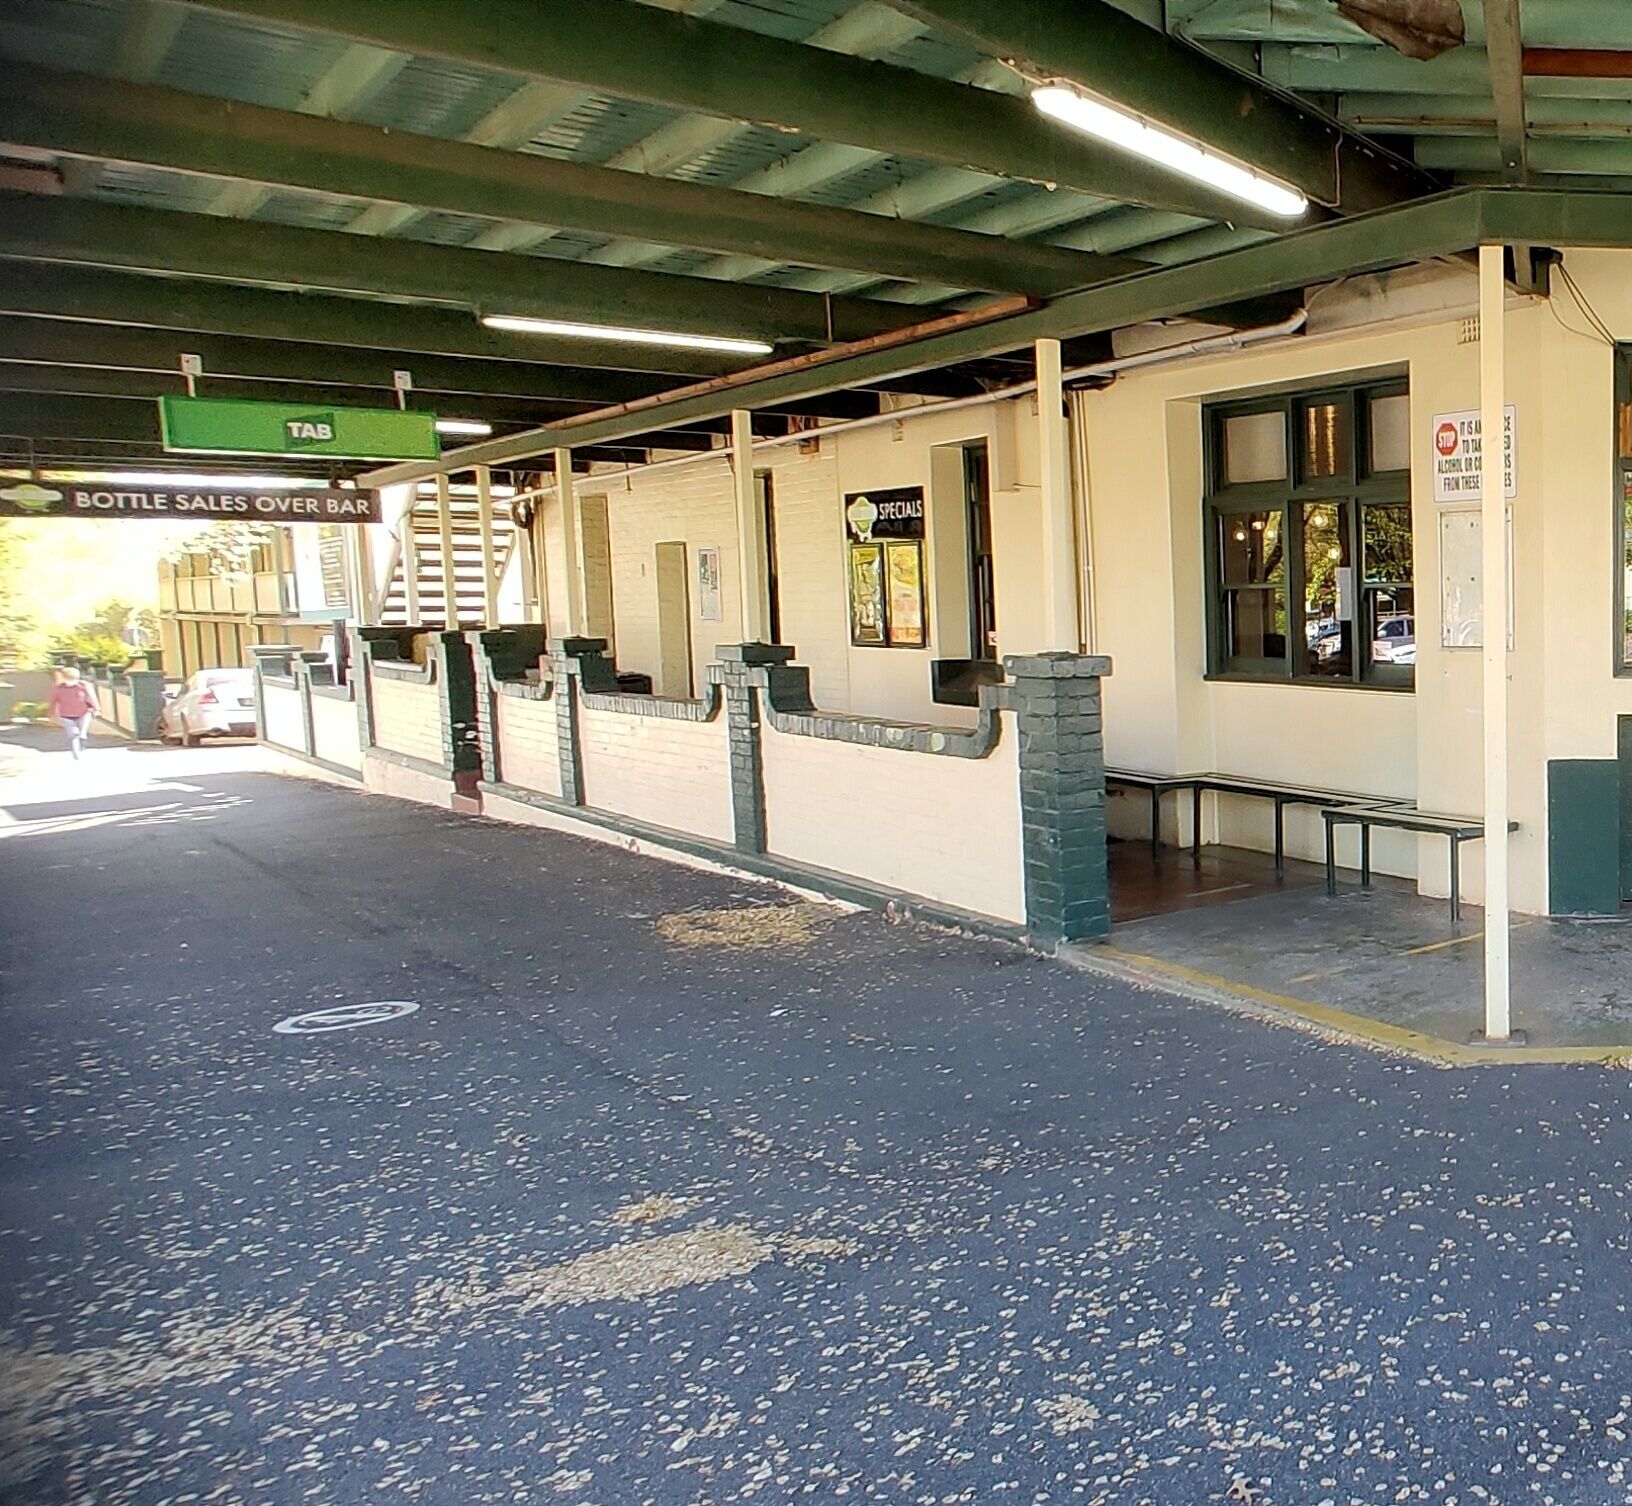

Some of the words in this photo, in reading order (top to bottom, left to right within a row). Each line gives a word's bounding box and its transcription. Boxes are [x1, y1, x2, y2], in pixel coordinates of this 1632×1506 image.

[287, 422, 332, 440] TAB
[1460, 420, 1466, 436] IT
[1467, 420, 1473, 435] IS
[1439, 431, 1456, 449] STOP
[1462, 439, 1470, 454] TO
[1471, 438, 1482, 453] TAK
[1438, 458, 1463, 474] ALCOHOL
[1464, 457, 1473, 472] OR
[1443, 476, 1460, 492] FROM
[1461, 474, 1480, 490] THESE
[75, 490, 169, 511] BOTTLE
[174, 492, 248, 512] SALES
[255, 495, 320, 514] OVER
[326, 498, 370, 515] BAR
[879, 500, 923, 520] SPECIALS
